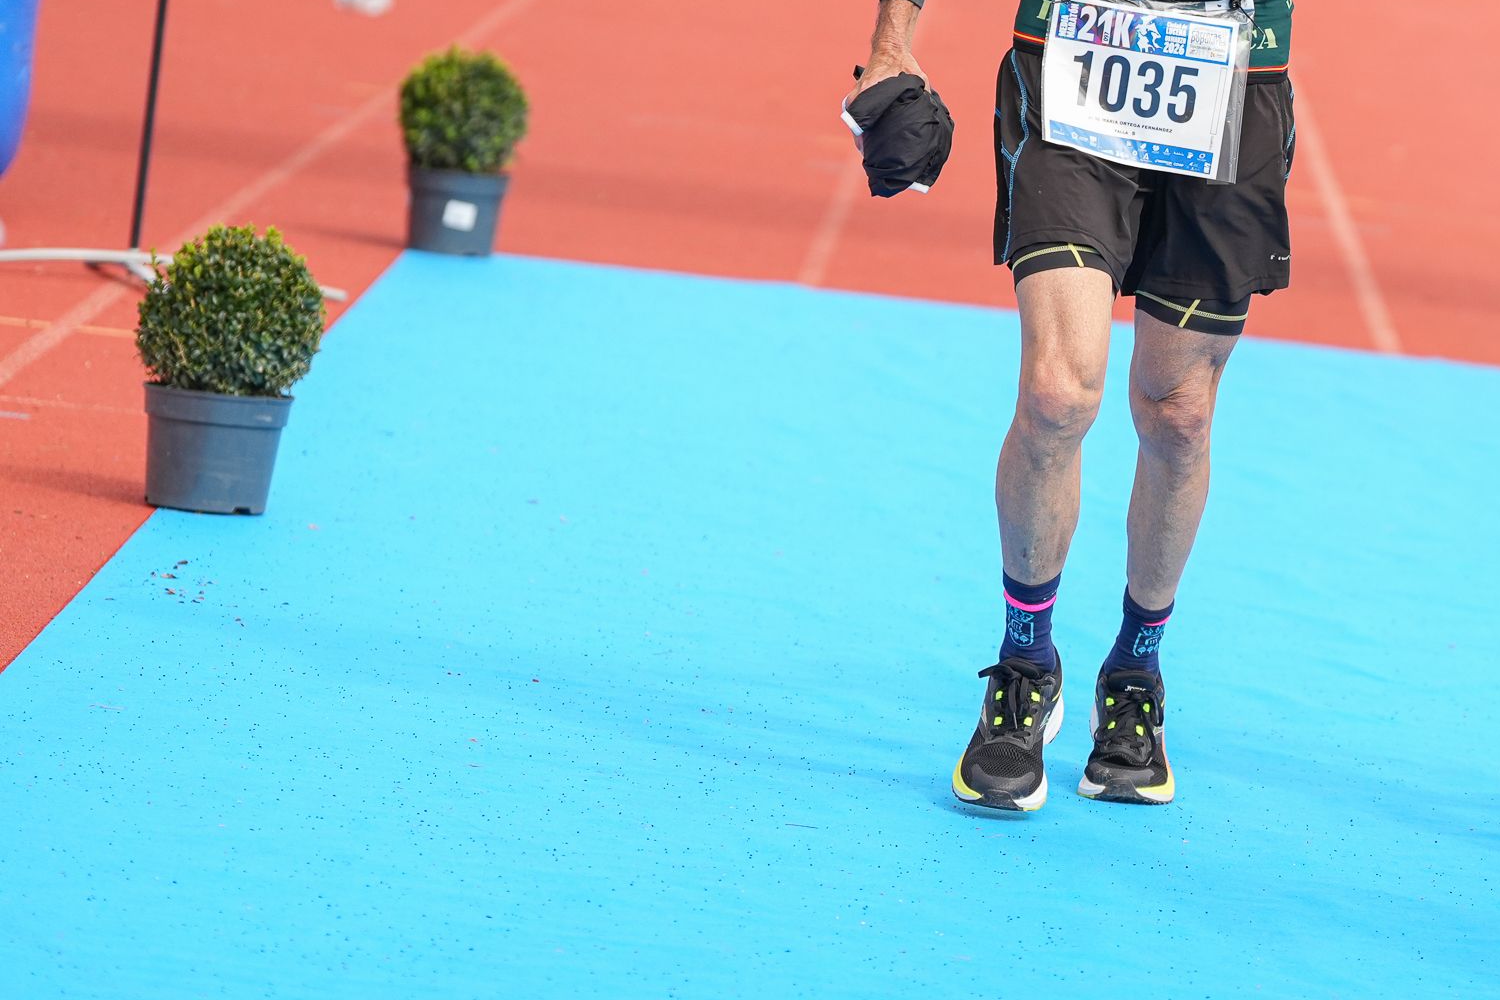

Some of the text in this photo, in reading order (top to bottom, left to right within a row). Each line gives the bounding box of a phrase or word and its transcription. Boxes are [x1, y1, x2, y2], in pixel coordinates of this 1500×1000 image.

[1077, 4, 1135, 48] 21K
[1163, 42, 1186, 56] 2026
[1073, 50, 1200, 124] 1035
[1119, 121, 1141, 129] ORTEGA
